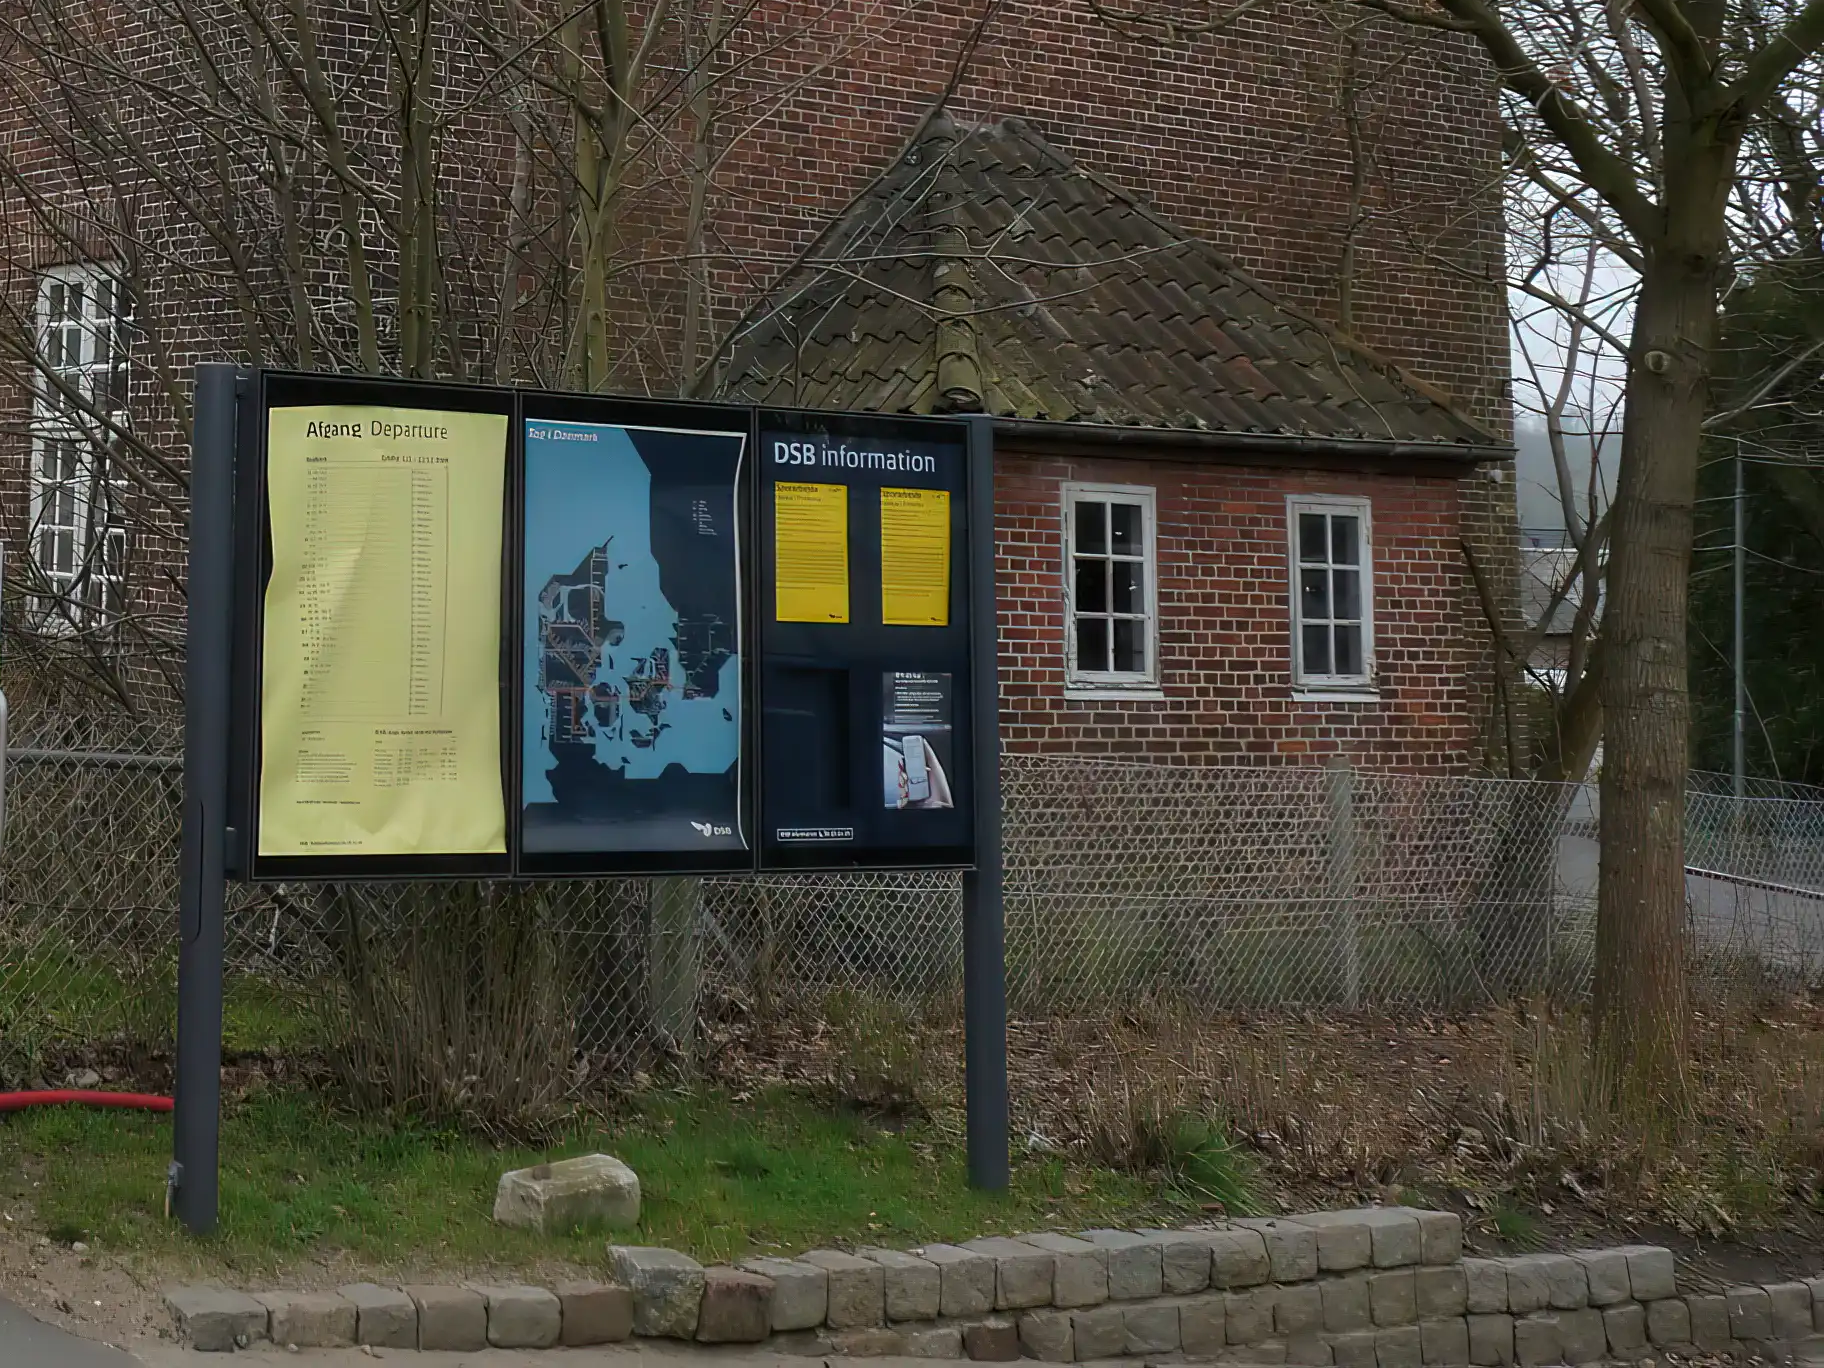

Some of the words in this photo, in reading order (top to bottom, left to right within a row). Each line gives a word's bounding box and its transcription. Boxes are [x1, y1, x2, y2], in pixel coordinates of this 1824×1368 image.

[306, 421, 362, 439] Afgang
[371, 420, 448, 440] Departure
[774, 442, 816, 466] DSB
[822, 444, 936, 473] information
